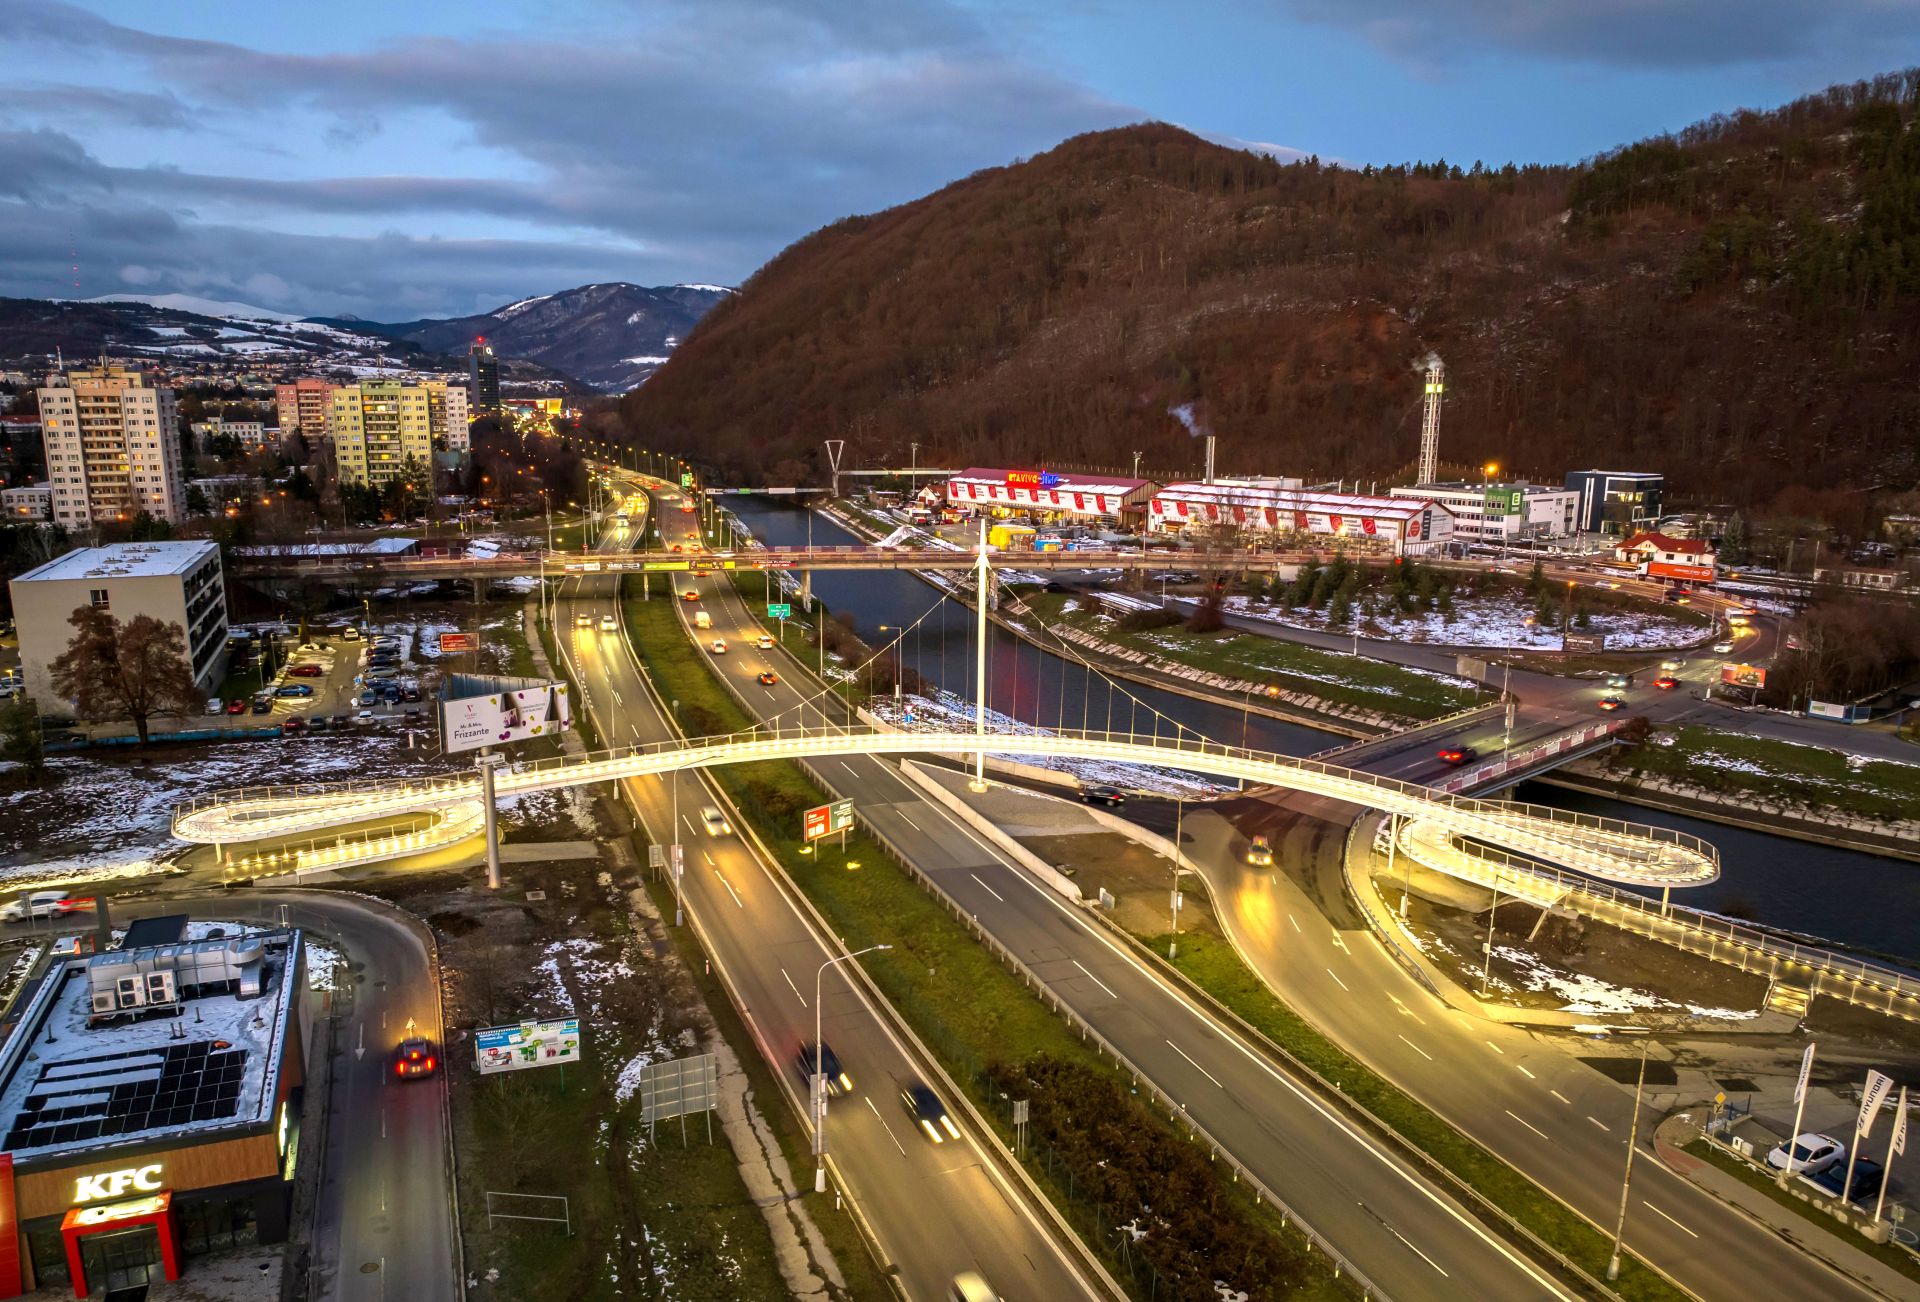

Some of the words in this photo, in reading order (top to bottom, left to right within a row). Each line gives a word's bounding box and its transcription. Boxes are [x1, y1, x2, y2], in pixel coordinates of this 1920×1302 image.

[454, 727, 490, 740] Frizzante
[1862, 1076, 1886, 1115] HYUNDAI
[74, 1164, 163, 1202] KFC
